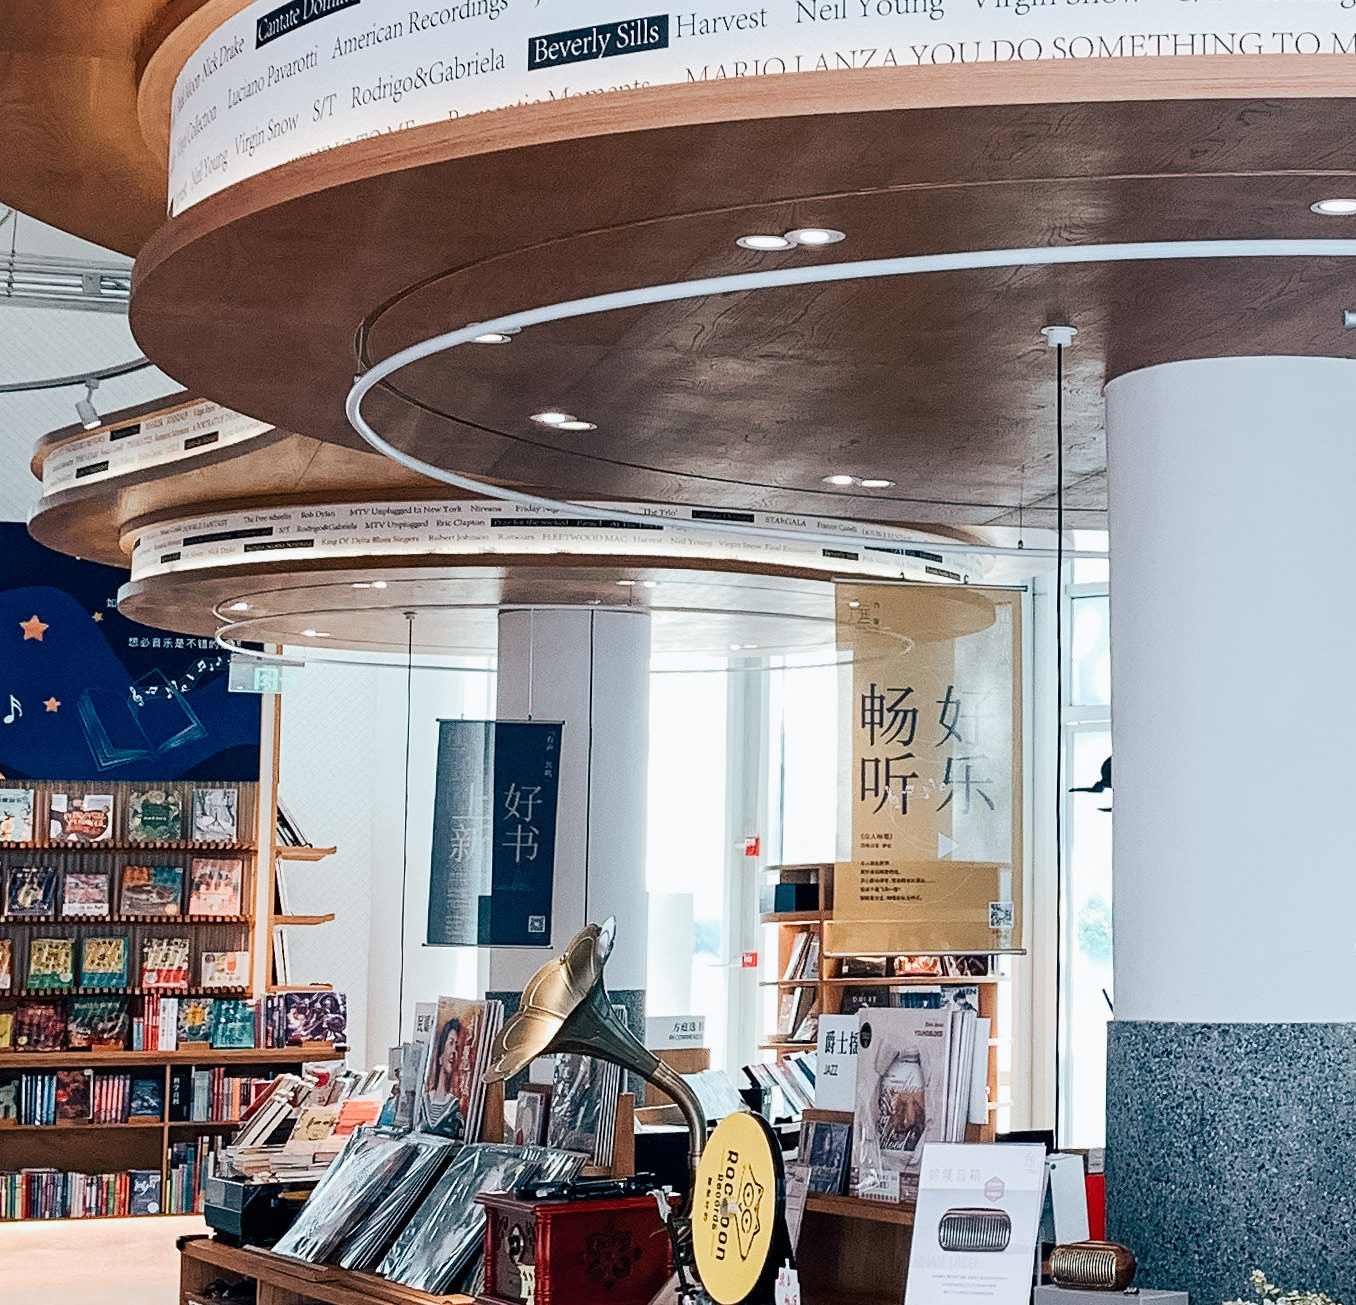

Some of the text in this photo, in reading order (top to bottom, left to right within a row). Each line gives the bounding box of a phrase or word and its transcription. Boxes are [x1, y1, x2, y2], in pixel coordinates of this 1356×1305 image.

[259, 9, 299, 42] Cantate
[534, 20, 660, 63] Beverly Sills
[503, 783, 543, 863] 好书
